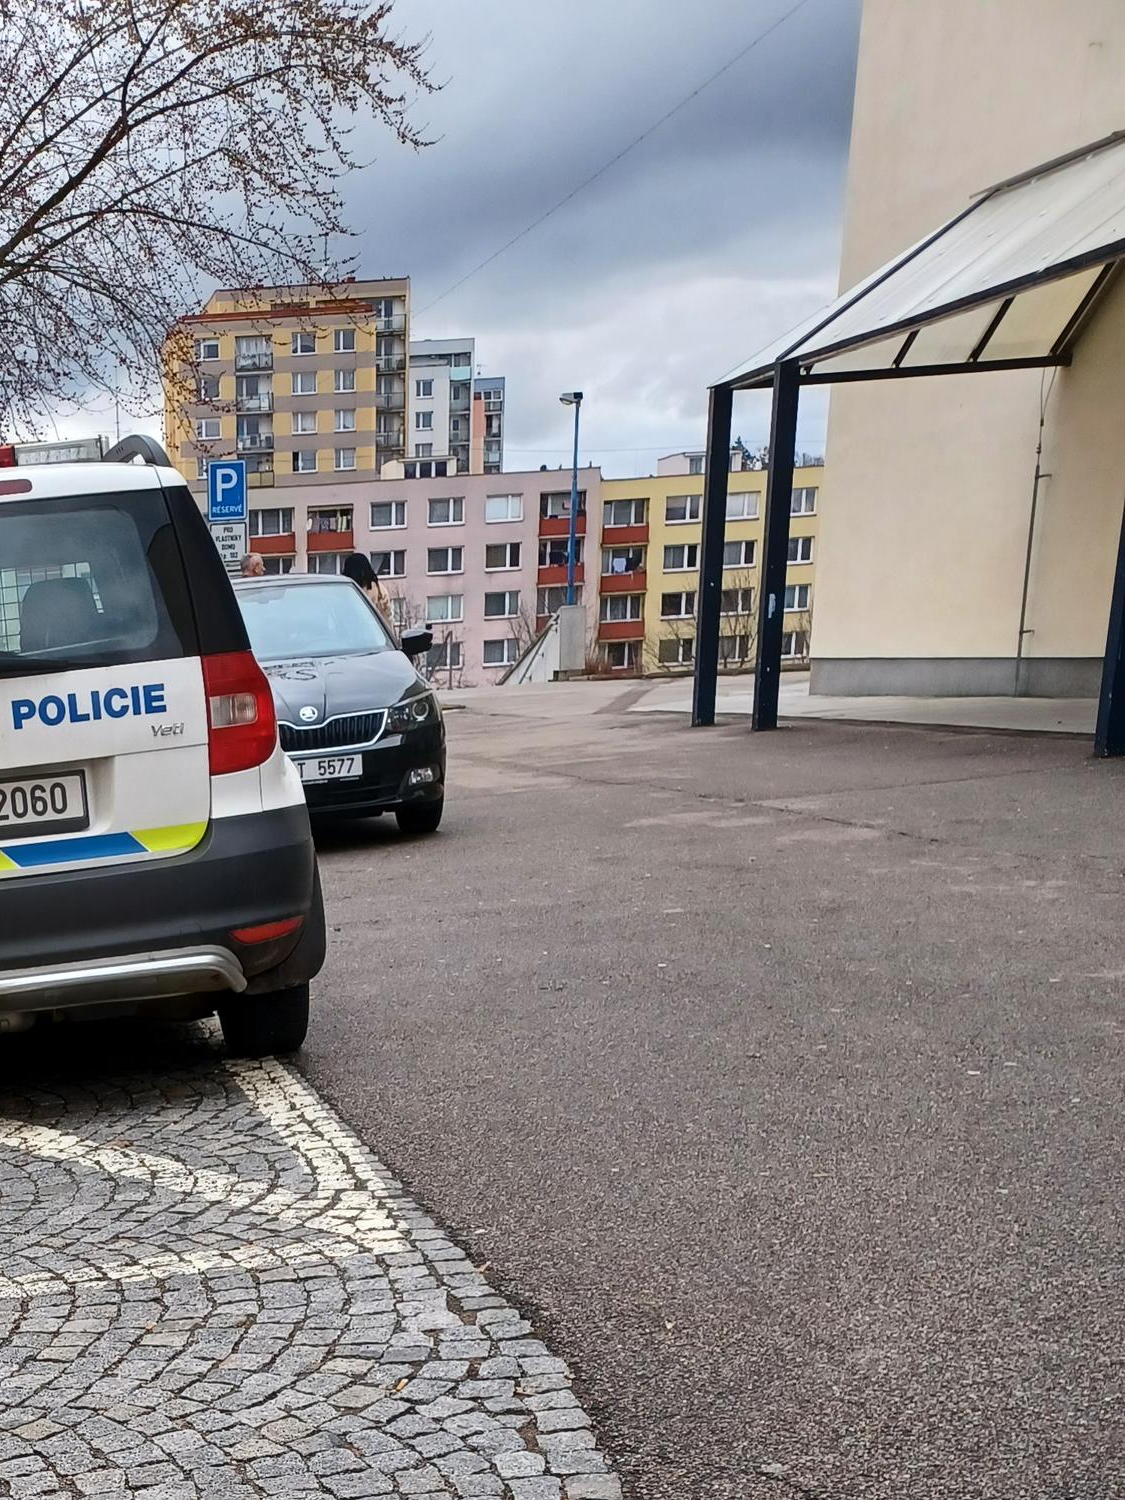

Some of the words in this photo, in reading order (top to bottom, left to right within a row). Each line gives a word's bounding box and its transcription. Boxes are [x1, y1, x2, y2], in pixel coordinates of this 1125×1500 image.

[216, 468, 238, 502] P
[11, 683, 168, 730] POLICIE
[318, 758, 355, 776] 5577
